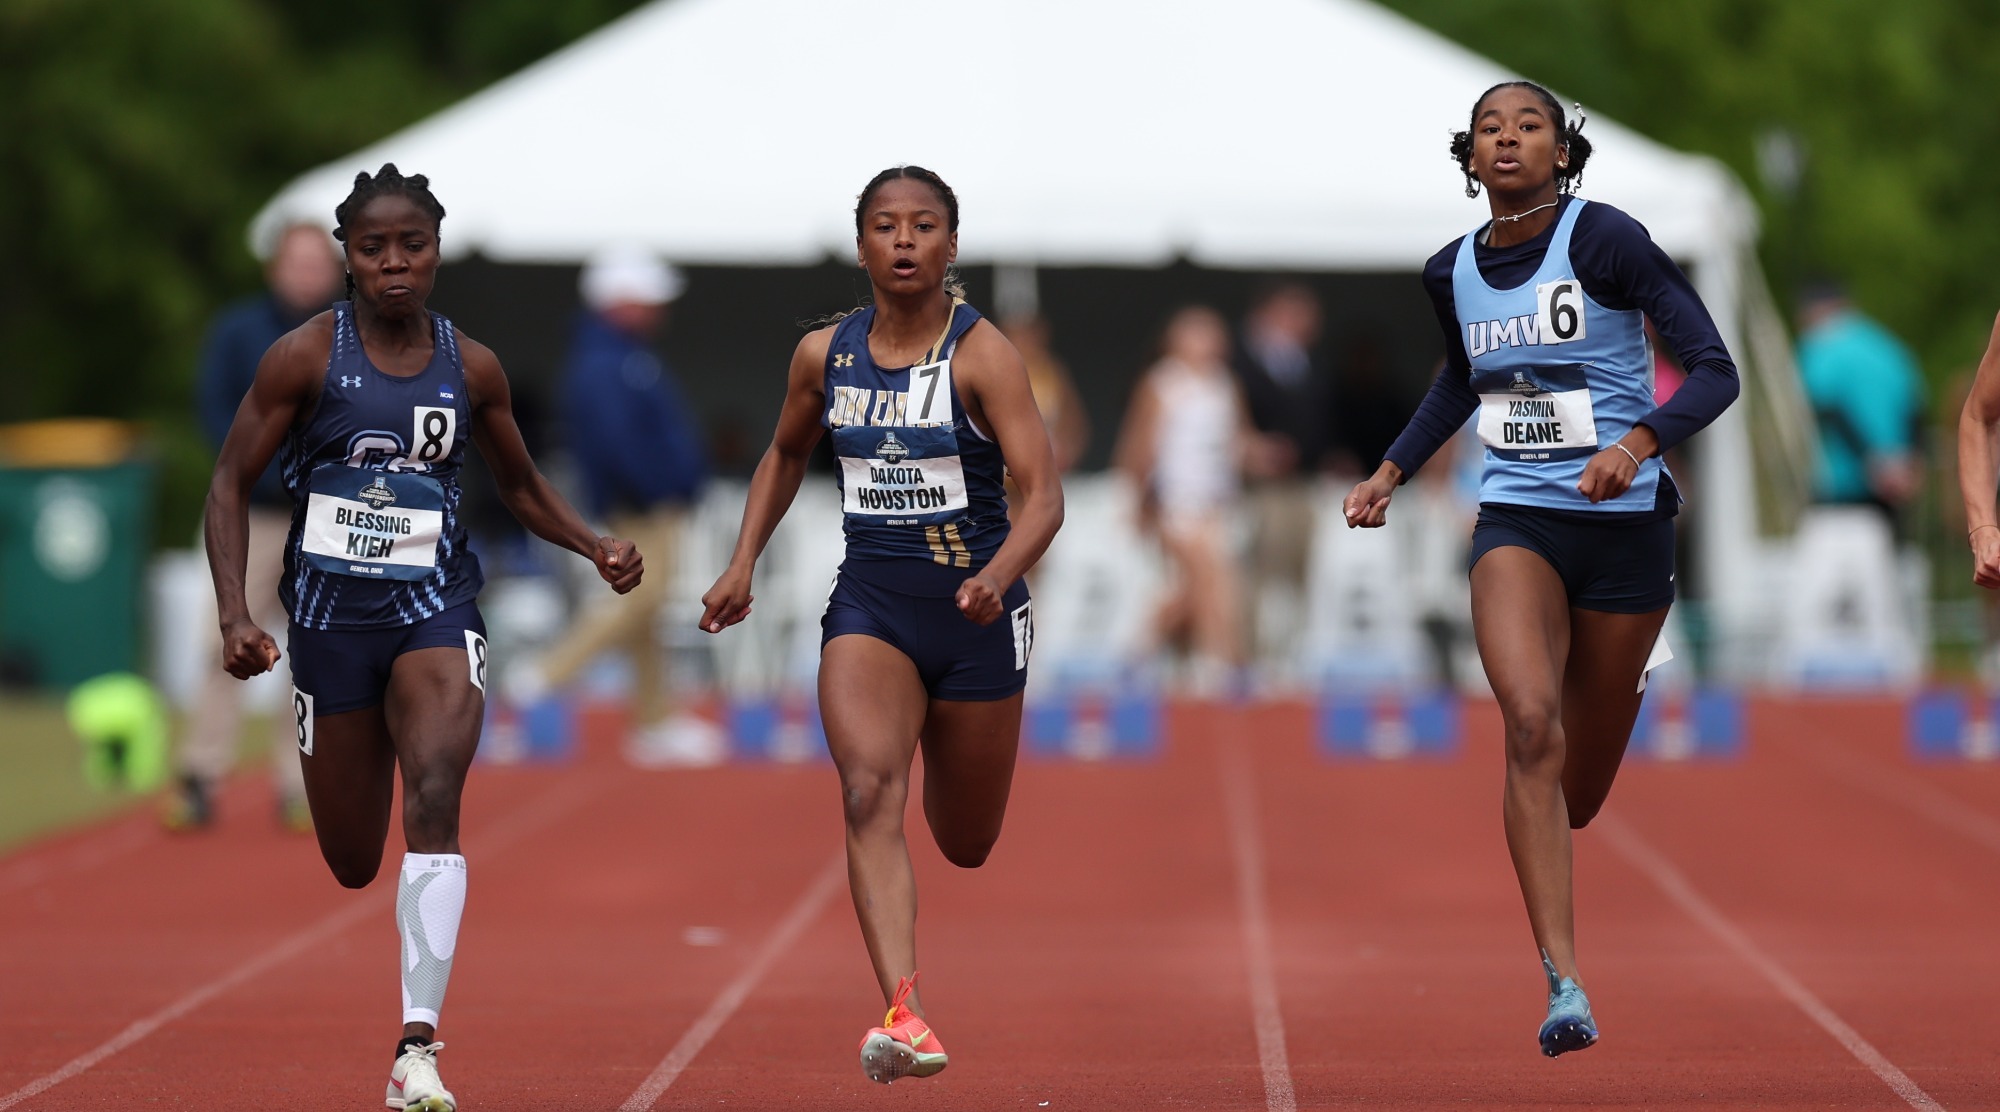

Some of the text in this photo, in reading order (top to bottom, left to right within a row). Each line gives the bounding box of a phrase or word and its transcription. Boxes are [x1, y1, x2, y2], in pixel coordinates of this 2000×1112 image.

[1549, 284, 1578, 340] 6
[918, 365, 941, 420] 7
[1508, 400, 1556, 418] YASMIN
[417, 410, 448, 462] 8
[1503, 421, 1564, 444] DEANE
[870, 466, 925, 485] DAKOTA
[858, 485, 947, 510] HOUSTON
[335, 507, 411, 535] BLESSING
[346, 532, 395, 558] KIEH
[1018, 606, 1030, 663] 7
[474, 637, 487, 689] 8
[295, 692, 307, 748] 8
